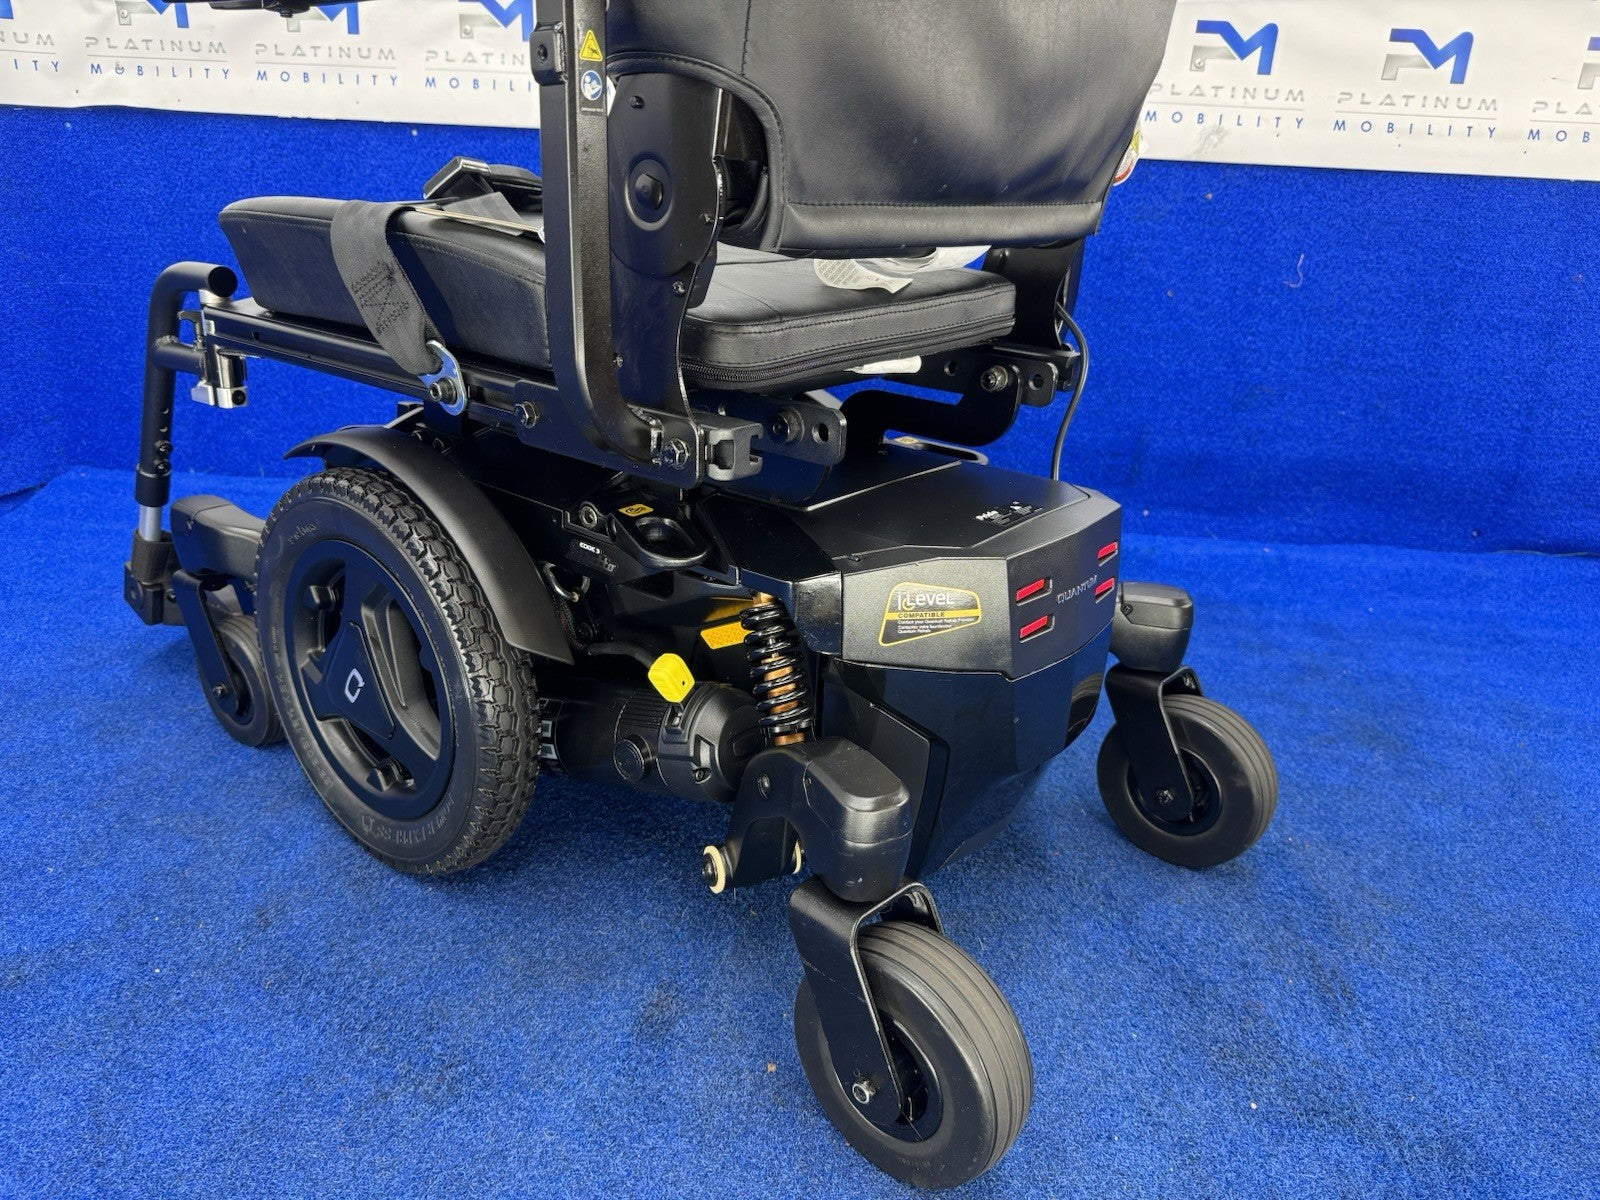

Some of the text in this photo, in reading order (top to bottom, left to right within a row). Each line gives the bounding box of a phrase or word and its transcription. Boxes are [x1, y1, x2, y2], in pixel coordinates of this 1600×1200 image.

[84, 36, 227, 54] PLATINUM
[255, 43, 397, 61] PLATINUM
[256, 70, 398, 87] MOBILITY
[424, 76, 532, 92] MOBILI
[1149, 82, 1305, 103] PLATINUM
[1336, 91, 1498, 112] PLATINUM
[1144, 110, 1304, 130] MOBILITY
[1333, 119, 1497, 139] MOBILITY
[1056, 574, 1098, 605] QUANTUM
[897, 611, 946, 620] COMPATIBLE
